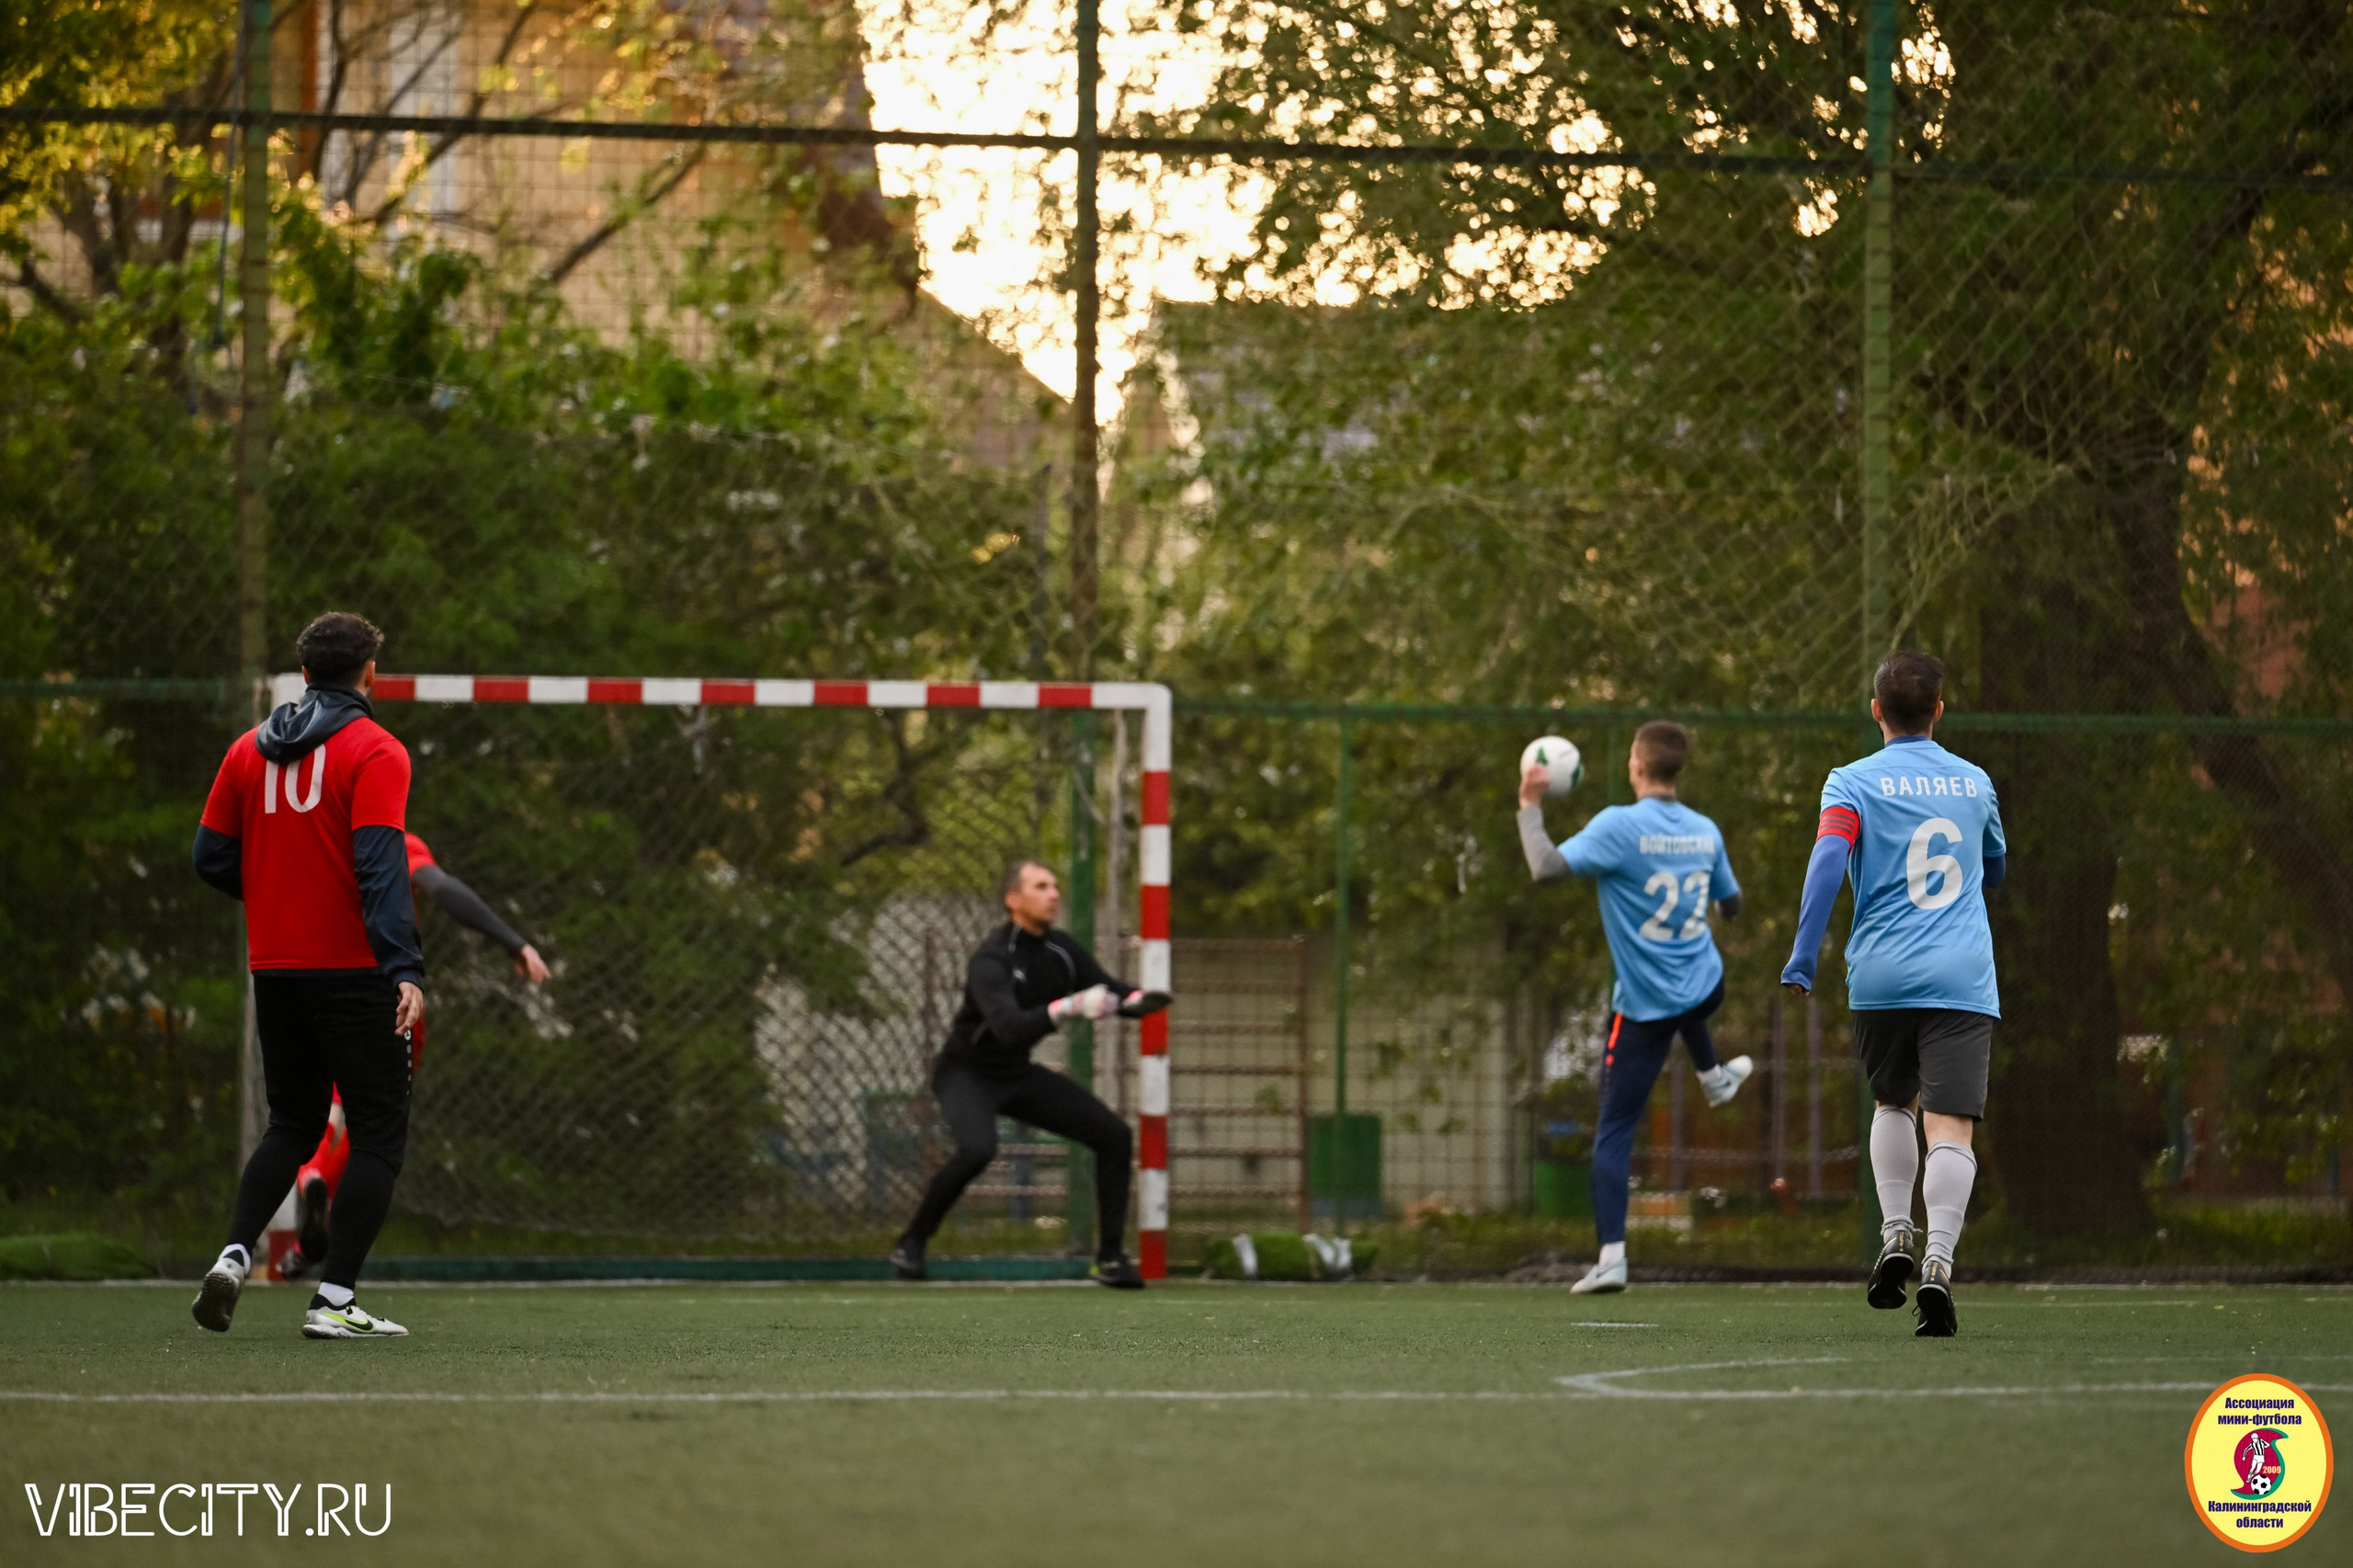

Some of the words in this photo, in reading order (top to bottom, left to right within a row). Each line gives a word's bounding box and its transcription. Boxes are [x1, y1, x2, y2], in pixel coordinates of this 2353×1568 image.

[1880, 776, 1978, 798] ВАЛЯЕВ
[1906, 817, 1963, 910] 6
[1639, 870, 1711, 942] 22
